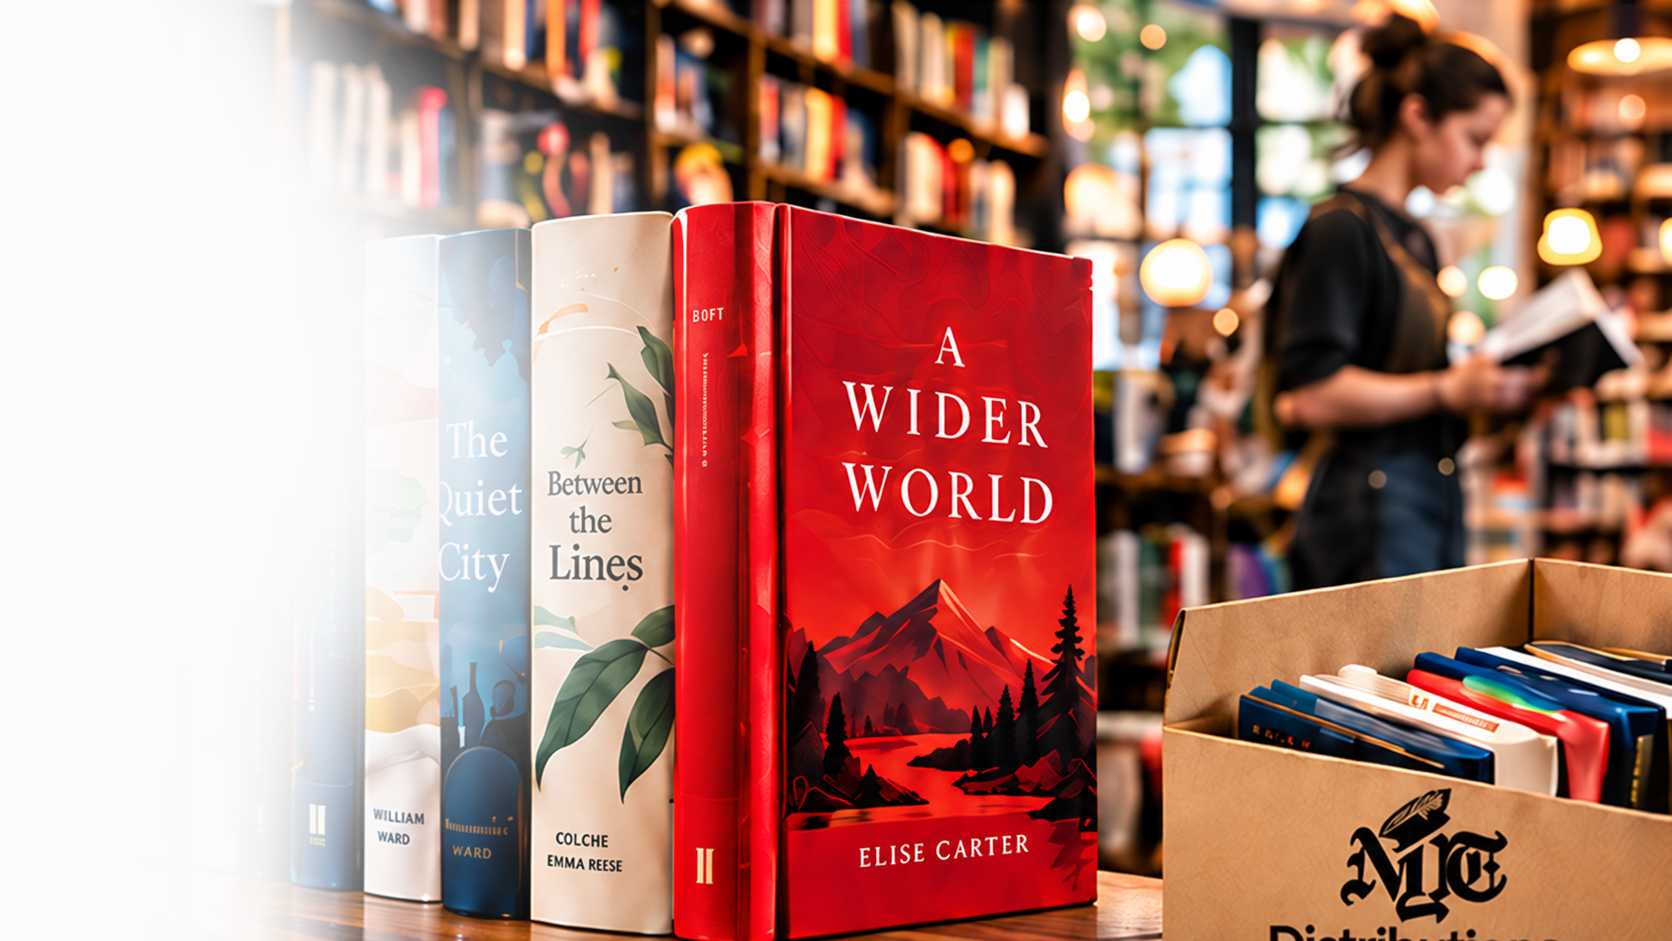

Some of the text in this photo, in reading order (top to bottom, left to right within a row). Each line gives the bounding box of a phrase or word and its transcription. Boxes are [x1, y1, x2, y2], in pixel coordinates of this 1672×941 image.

[692, 307, 724, 323] BOFT
[934, 326, 966, 368] A
[842, 380, 1049, 449] WIDER
[445, 418, 508, 459] The
[547, 470, 643, 496] Between
[841, 461, 1053, 524] WORLD
[568, 505, 613, 534] the
[438, 541, 510, 594] City
[549, 543, 644, 591] Lines
[373, 808, 425, 826] WILLIAM
[377, 830, 411, 846] WARD
[452, 845, 492, 860] WARD
[555, 831, 609, 848] COLCHE
[859, 834, 1029, 868] ELISE CARTER
[547, 854, 623, 873] EMMA REESE
